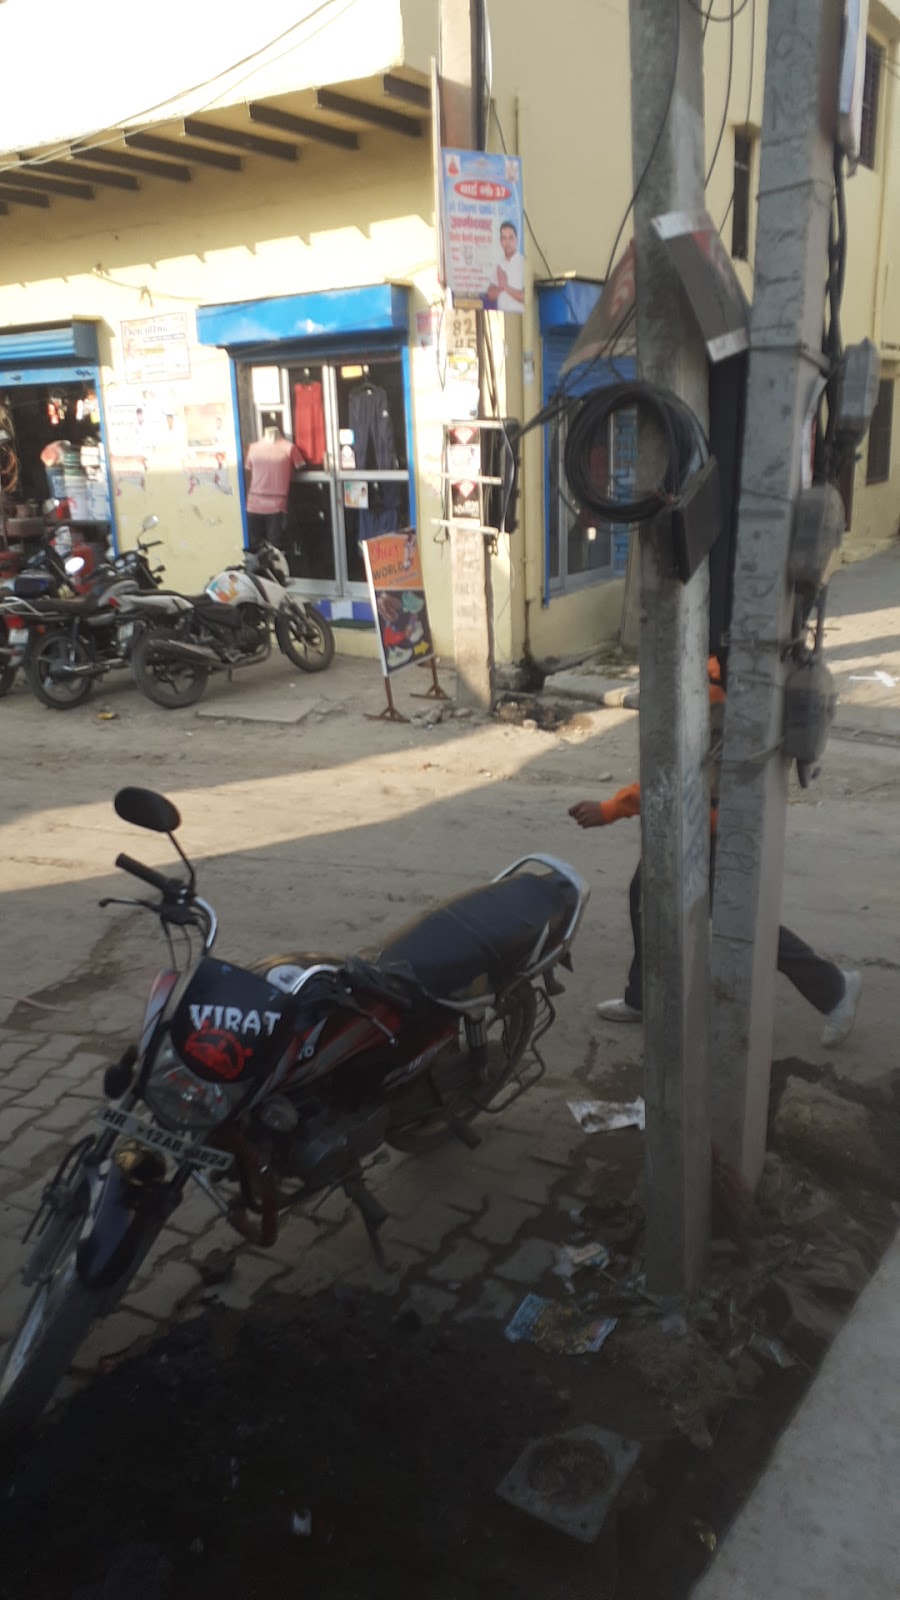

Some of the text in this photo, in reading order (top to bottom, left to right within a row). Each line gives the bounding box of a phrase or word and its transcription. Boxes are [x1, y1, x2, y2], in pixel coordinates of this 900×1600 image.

[373, 561, 404, 580] WORLD
[190, 1004, 281, 1036] VIRAT
[103, 1110, 127, 1128] HR
